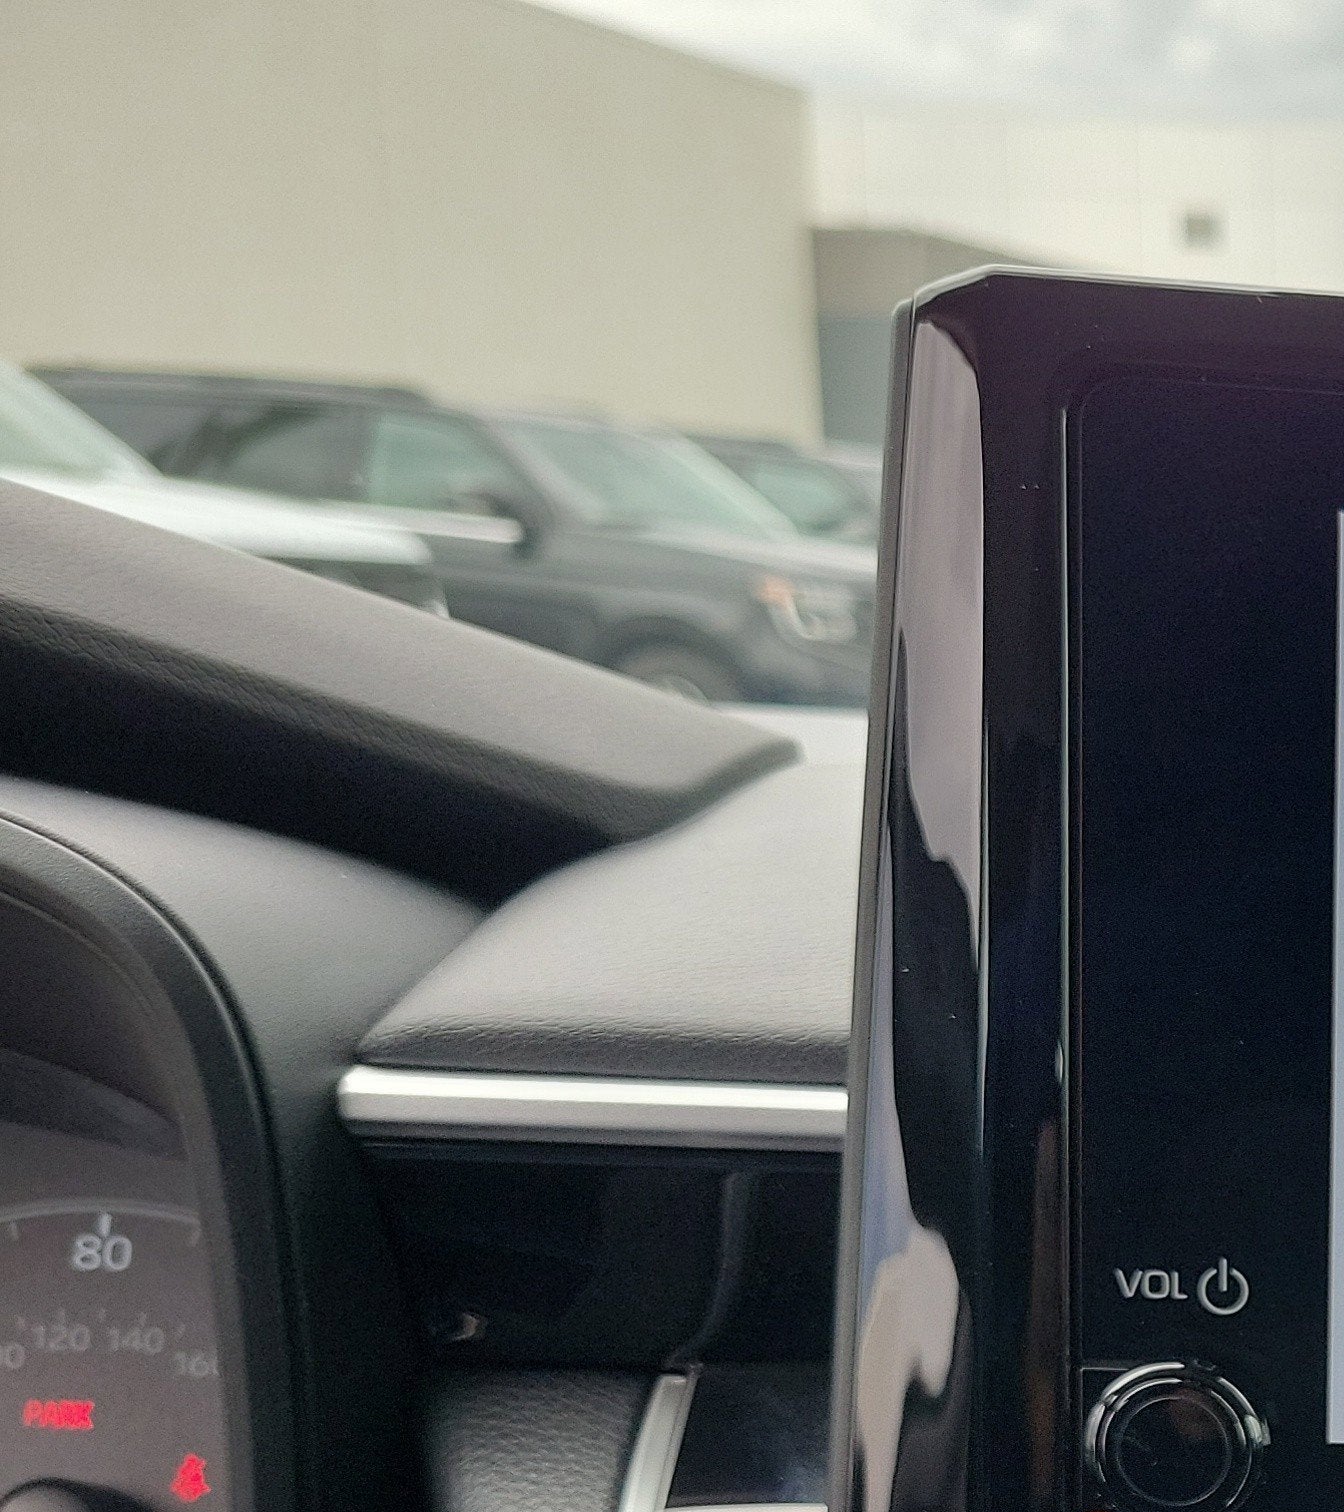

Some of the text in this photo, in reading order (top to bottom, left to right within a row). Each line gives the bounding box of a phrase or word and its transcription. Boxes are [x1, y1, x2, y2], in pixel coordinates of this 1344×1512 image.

[71, 1233, 133, 1271] 80
[1112, 1267, 1189, 1300] VOL
[33, 1323, 166, 1355] 120 140
